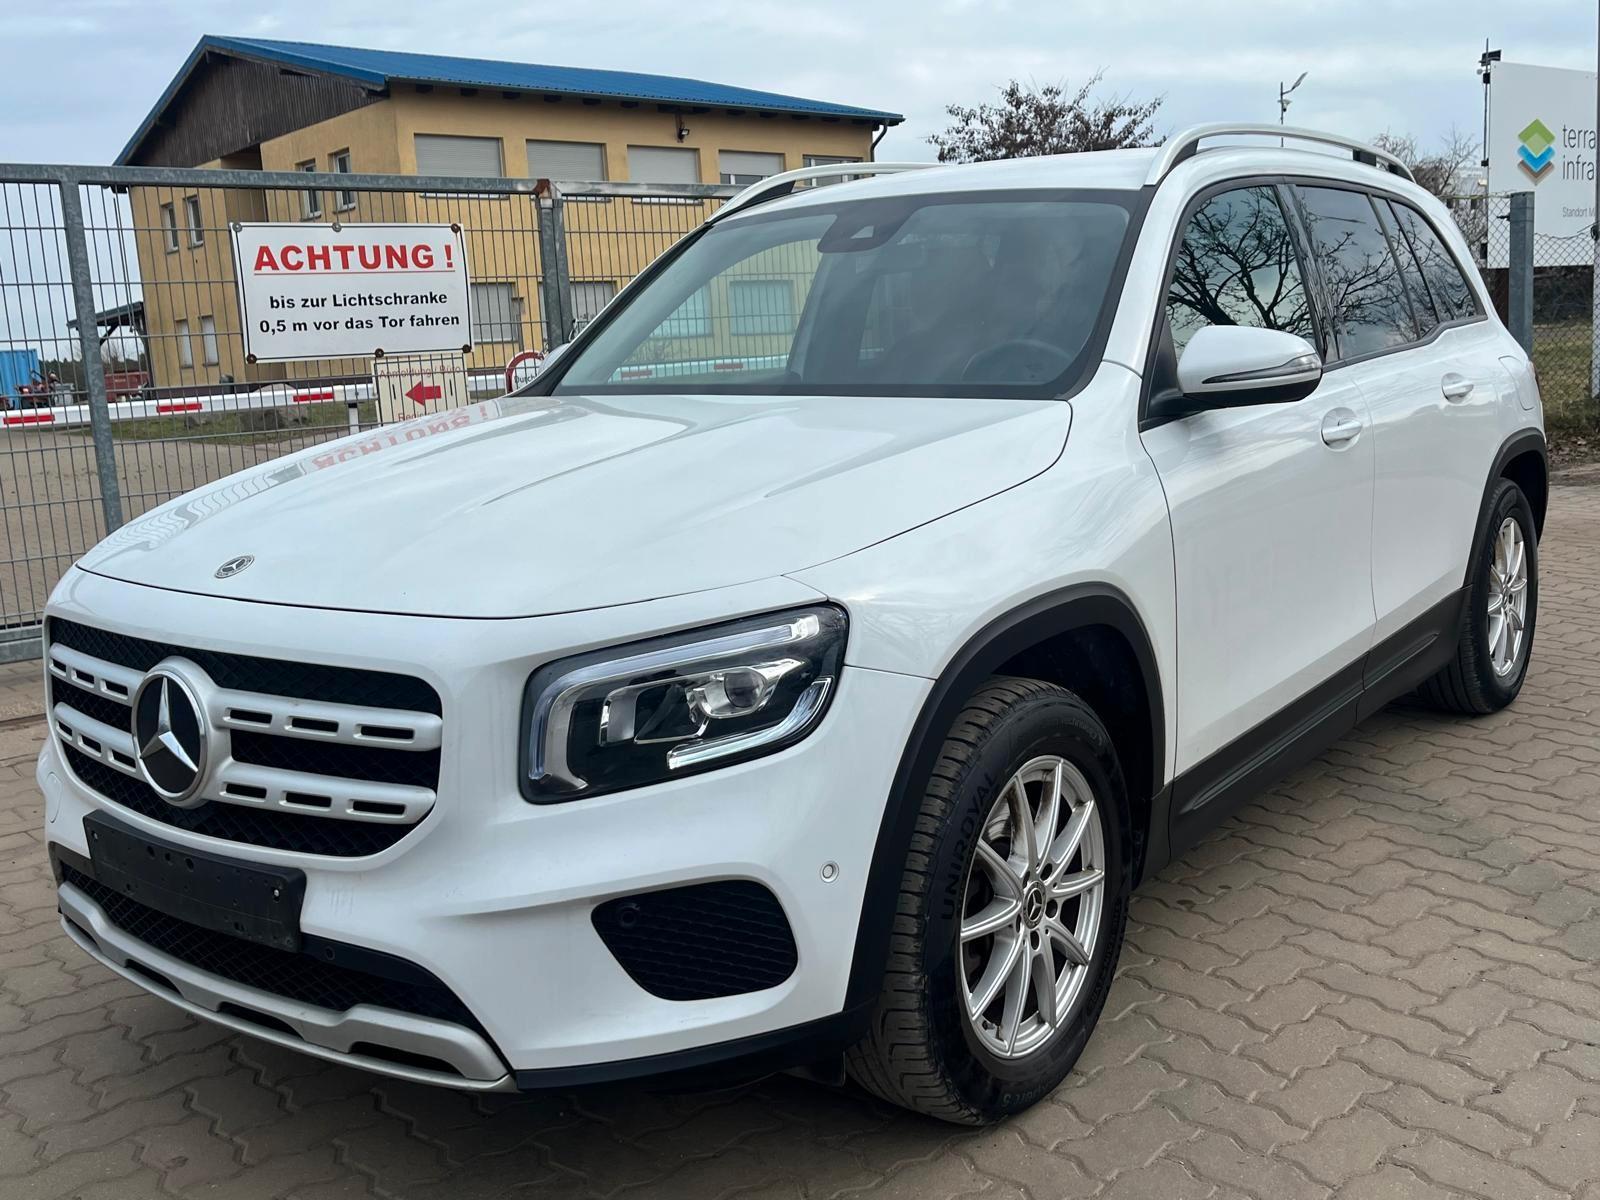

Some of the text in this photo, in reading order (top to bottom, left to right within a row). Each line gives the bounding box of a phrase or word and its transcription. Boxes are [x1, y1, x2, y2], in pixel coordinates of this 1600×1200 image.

[1562, 124, 1596, 149] terra
[1562, 154, 1595, 180] infra
[254, 244, 454, 271] ACHTUNG !
[269, 291, 448, 309] bis zur Lichtschranke
[259, 314, 460, 335] 0,5 m vor das Tor fahren
[941, 772, 998, 920] UNIROYAL
